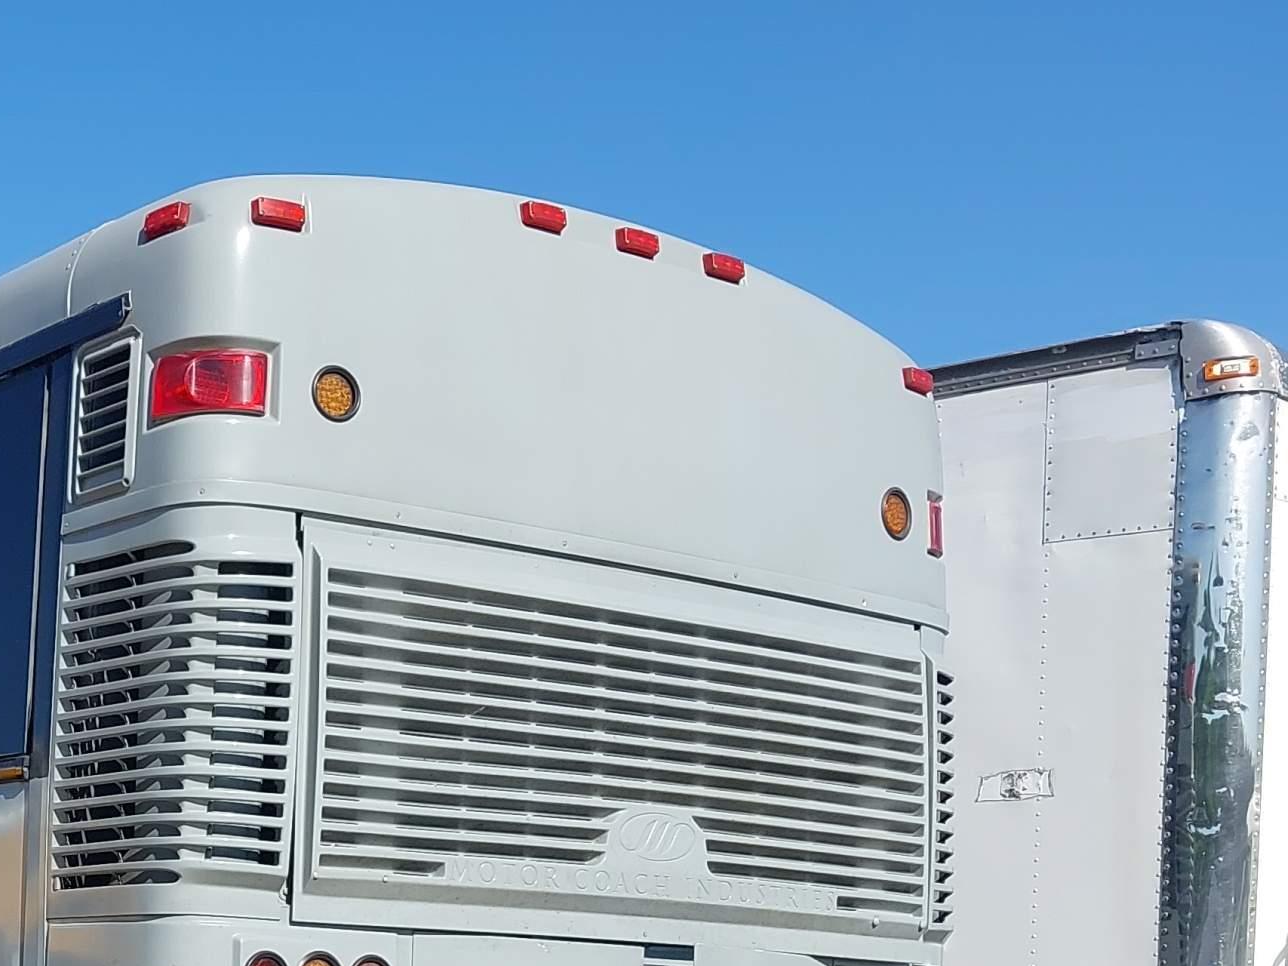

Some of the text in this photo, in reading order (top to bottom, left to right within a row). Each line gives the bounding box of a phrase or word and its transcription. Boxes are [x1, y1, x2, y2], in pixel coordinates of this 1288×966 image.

[449, 859, 835, 912] MOTOR COACH INDUSTRIES
